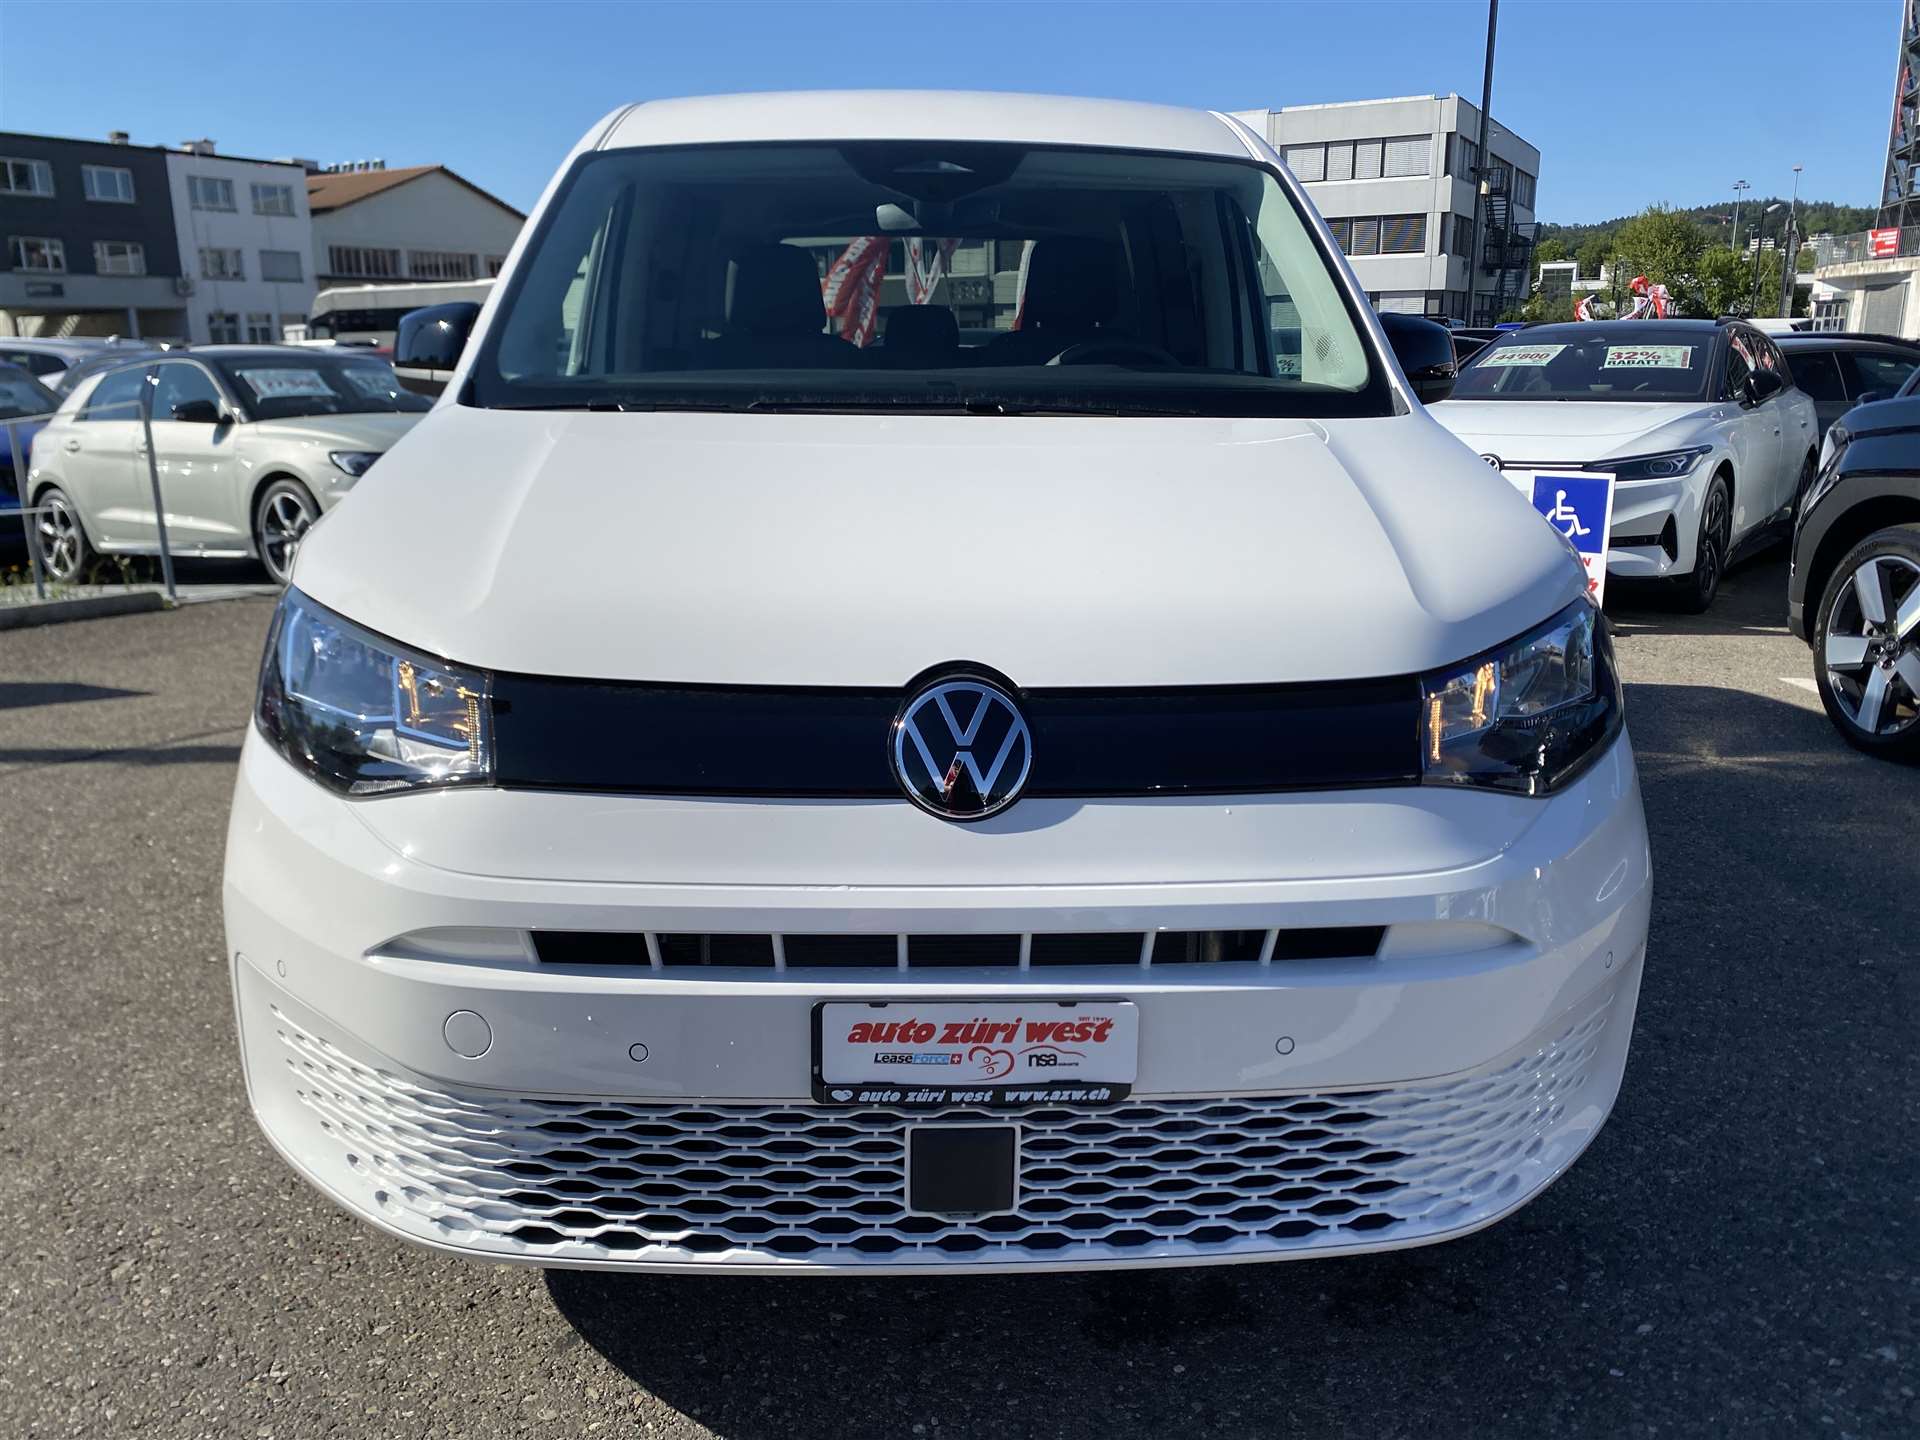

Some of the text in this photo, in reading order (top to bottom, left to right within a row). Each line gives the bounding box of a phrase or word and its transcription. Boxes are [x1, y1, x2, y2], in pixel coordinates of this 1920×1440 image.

[1608, 351, 1662, 360] 32%
[896, 682, 1032, 804] VW
[847, 1017, 1114, 1044] auto züri west
[873, 1052, 950, 1064] LeaseForce
[1028, 1054, 1058, 1067] nsa
[858, 1087, 1111, 1103] auto züri west www.azw.ch
